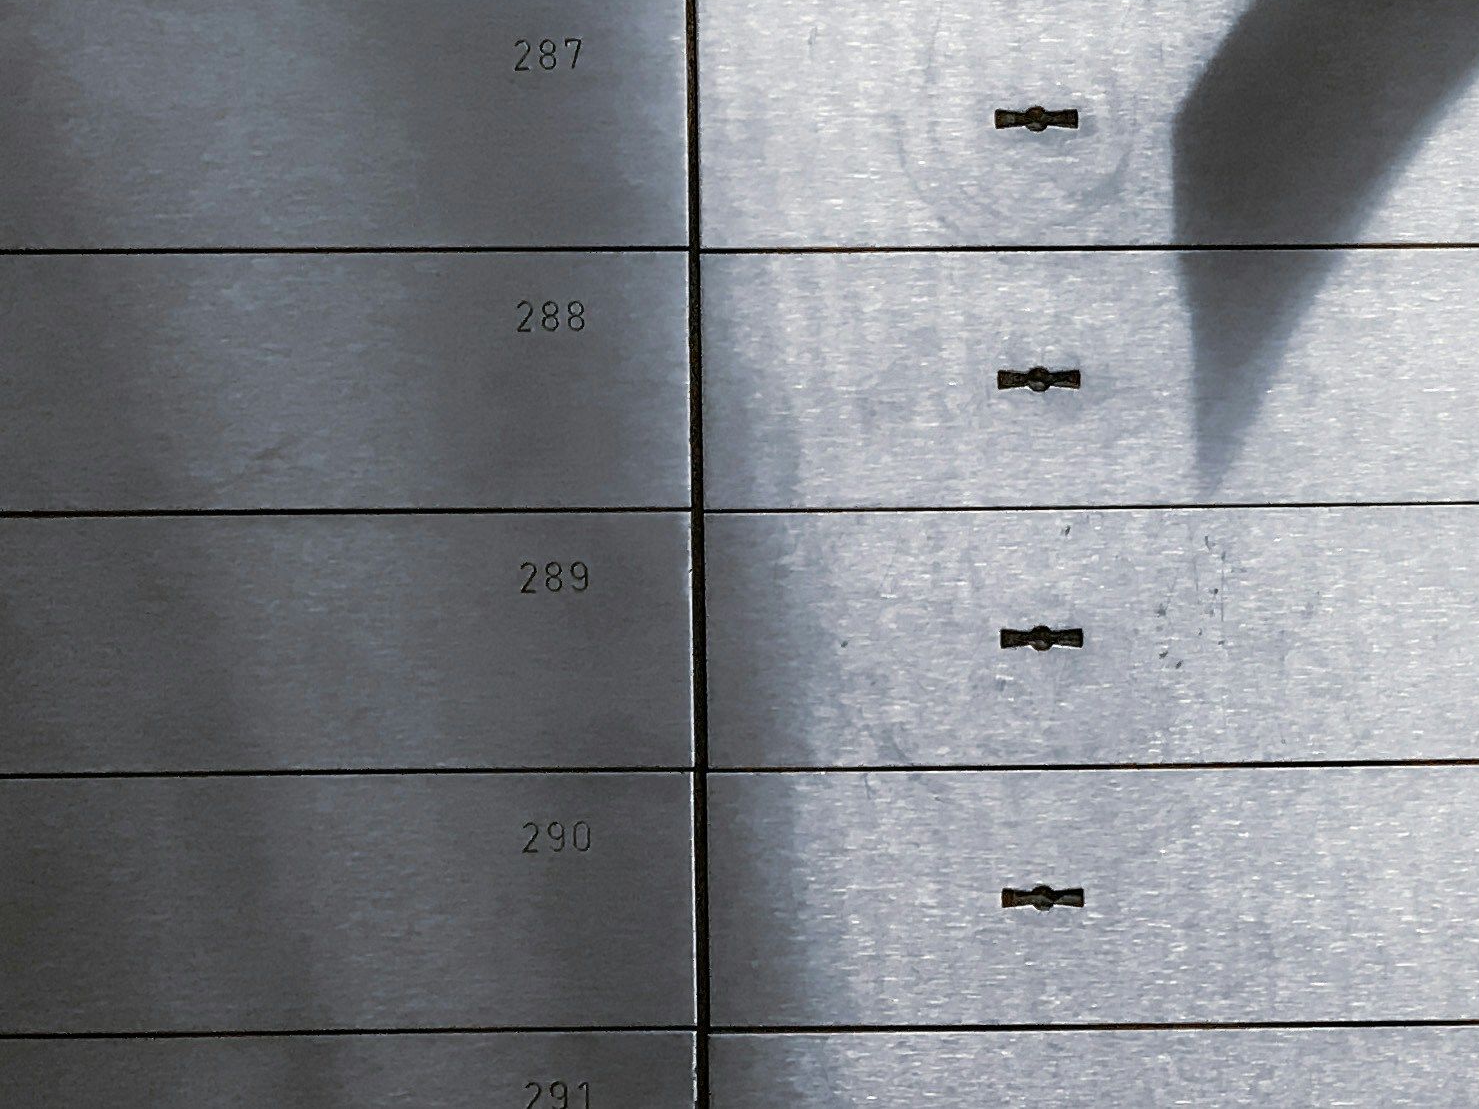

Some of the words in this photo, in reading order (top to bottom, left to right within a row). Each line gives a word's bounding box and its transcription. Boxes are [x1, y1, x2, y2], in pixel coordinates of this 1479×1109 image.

[513, 38, 583, 71] 287
[516, 300, 586, 333] 288
[519, 561, 589, 594] 289
[521, 820, 592, 853] 290
[524, 1080, 591, 1109] 291
